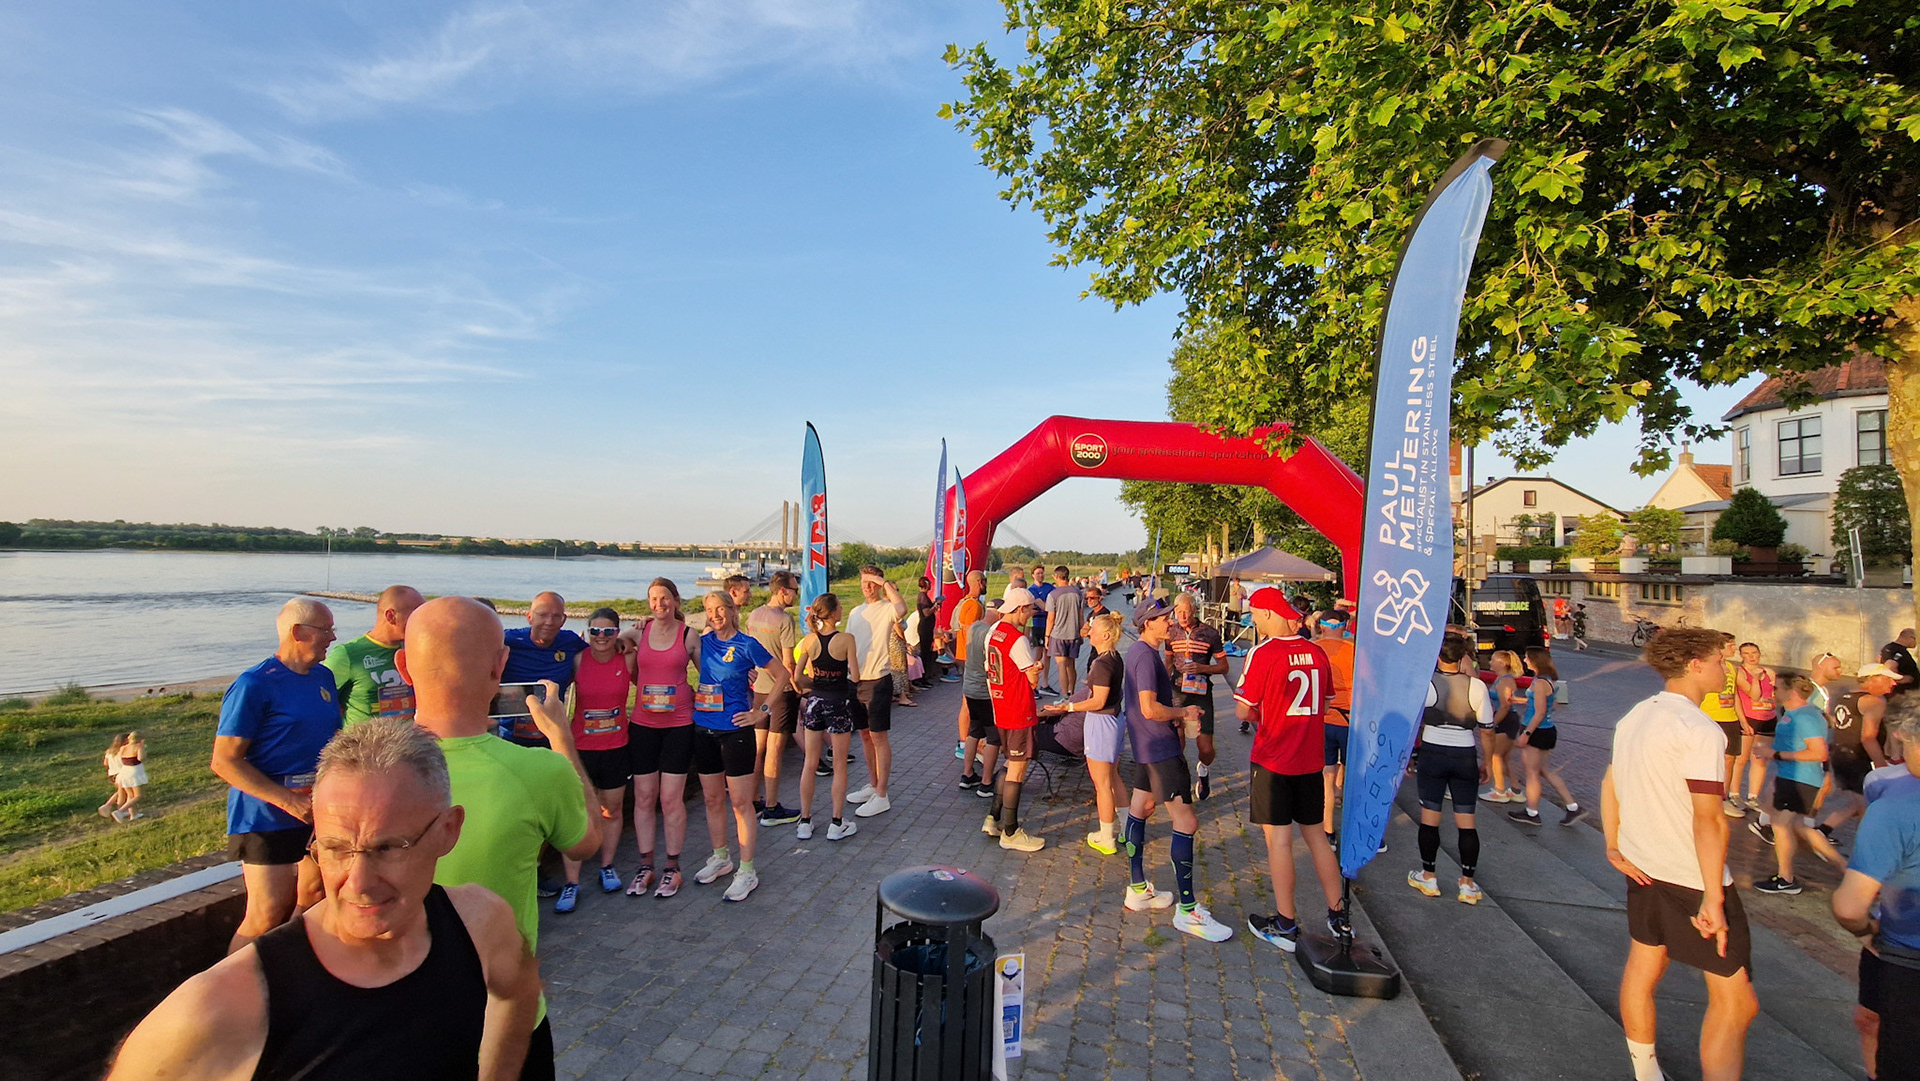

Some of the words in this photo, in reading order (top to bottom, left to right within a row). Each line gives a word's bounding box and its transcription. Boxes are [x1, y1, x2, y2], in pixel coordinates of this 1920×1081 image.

[1428, 334, 1438, 378] STEEL
[1422, 382, 1434, 456] STAINLESS
[1074, 443, 1104, 452] SPORT
[1076, 451, 1101, 459] 2000
[1112, 447, 1135, 455] your
[1138, 447, 1207, 458] professional
[1209, 449, 1269, 461] sportshop
[1399, 336, 1428, 551] MEIJERING
[1421, 460, 1429, 474] IN
[1379, 450, 1400, 545] PAUL
[1416, 477, 1428, 553] SPECIALIST
[1425, 489, 1437, 543] SPECIAL
[1423, 547, 1433, 556] &
[1288, 653, 1314, 666] LAHM
[1286, 668, 1319, 716] 21
